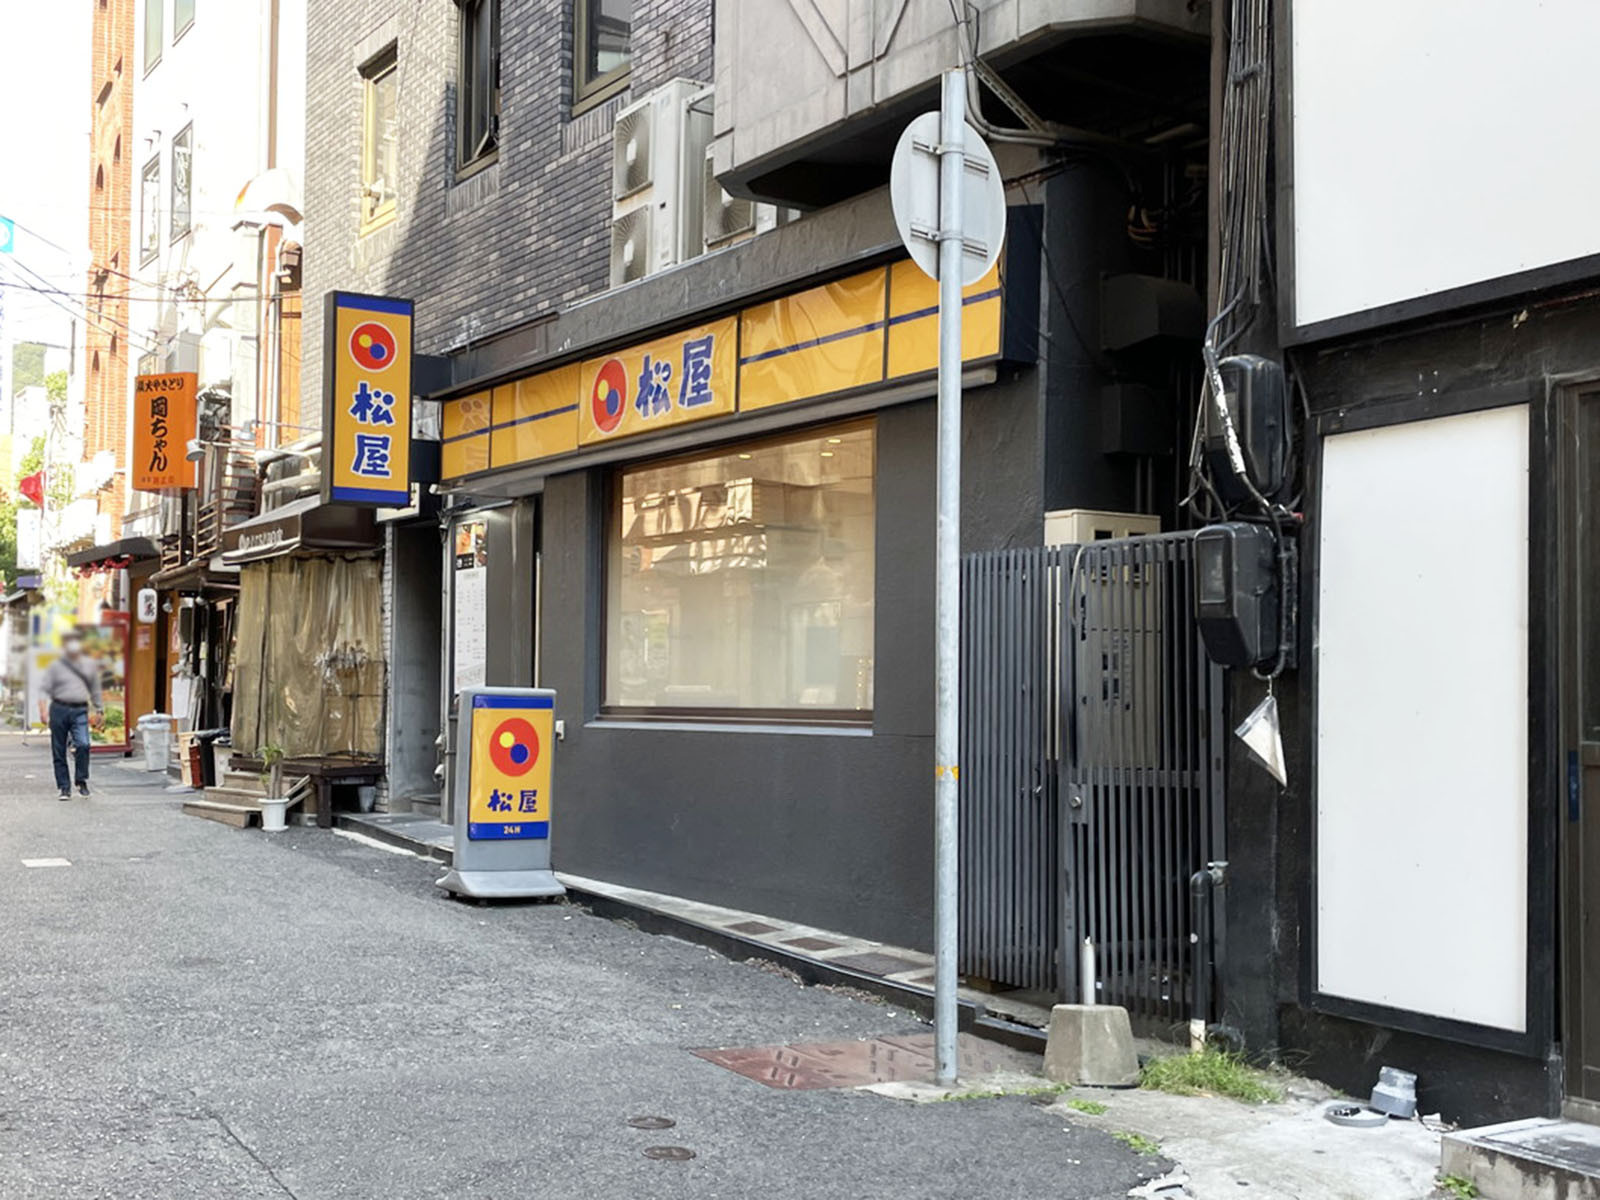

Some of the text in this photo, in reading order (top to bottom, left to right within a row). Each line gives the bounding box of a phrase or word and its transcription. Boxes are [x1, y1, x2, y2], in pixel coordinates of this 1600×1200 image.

[634, 334, 715, 419] 松屋
[149, 395, 168, 473] 岡ちゃん
[349, 382, 394, 478] 松屋
[487, 788, 538, 814] 松屋
